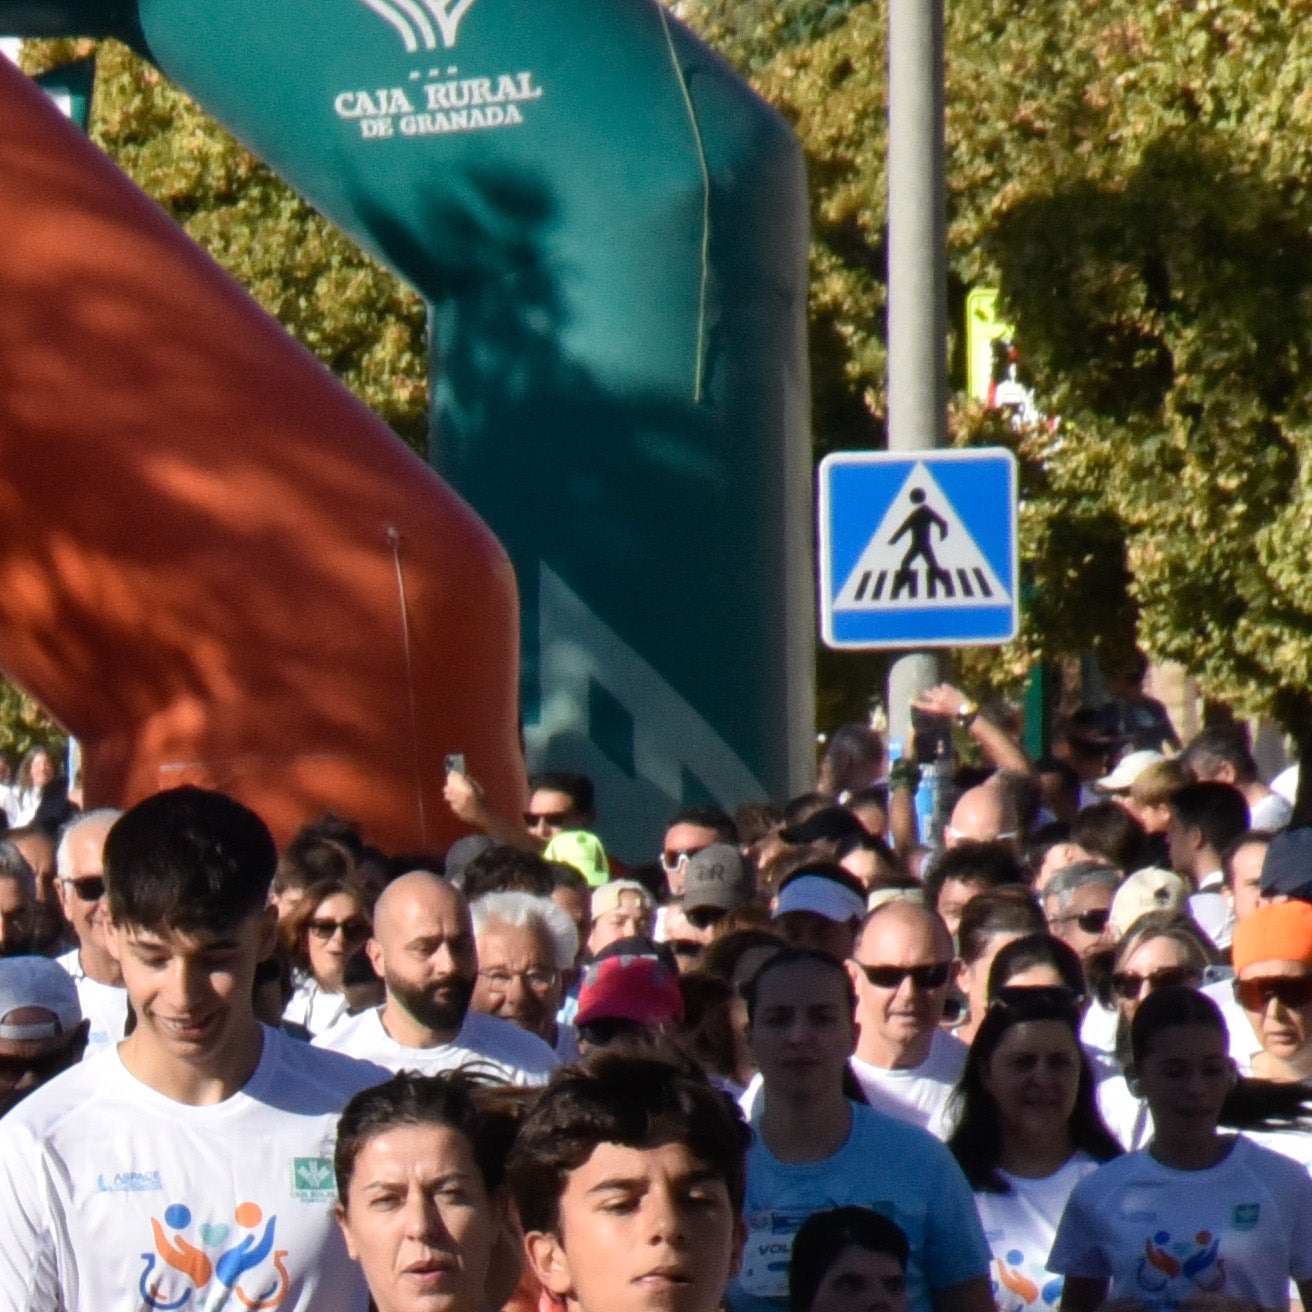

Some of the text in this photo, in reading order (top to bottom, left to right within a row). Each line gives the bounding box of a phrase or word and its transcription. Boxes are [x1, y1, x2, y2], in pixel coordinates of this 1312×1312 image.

[333, 71, 543, 119] CAJA RURAL
[360, 103, 524, 139] DE GRANADA
